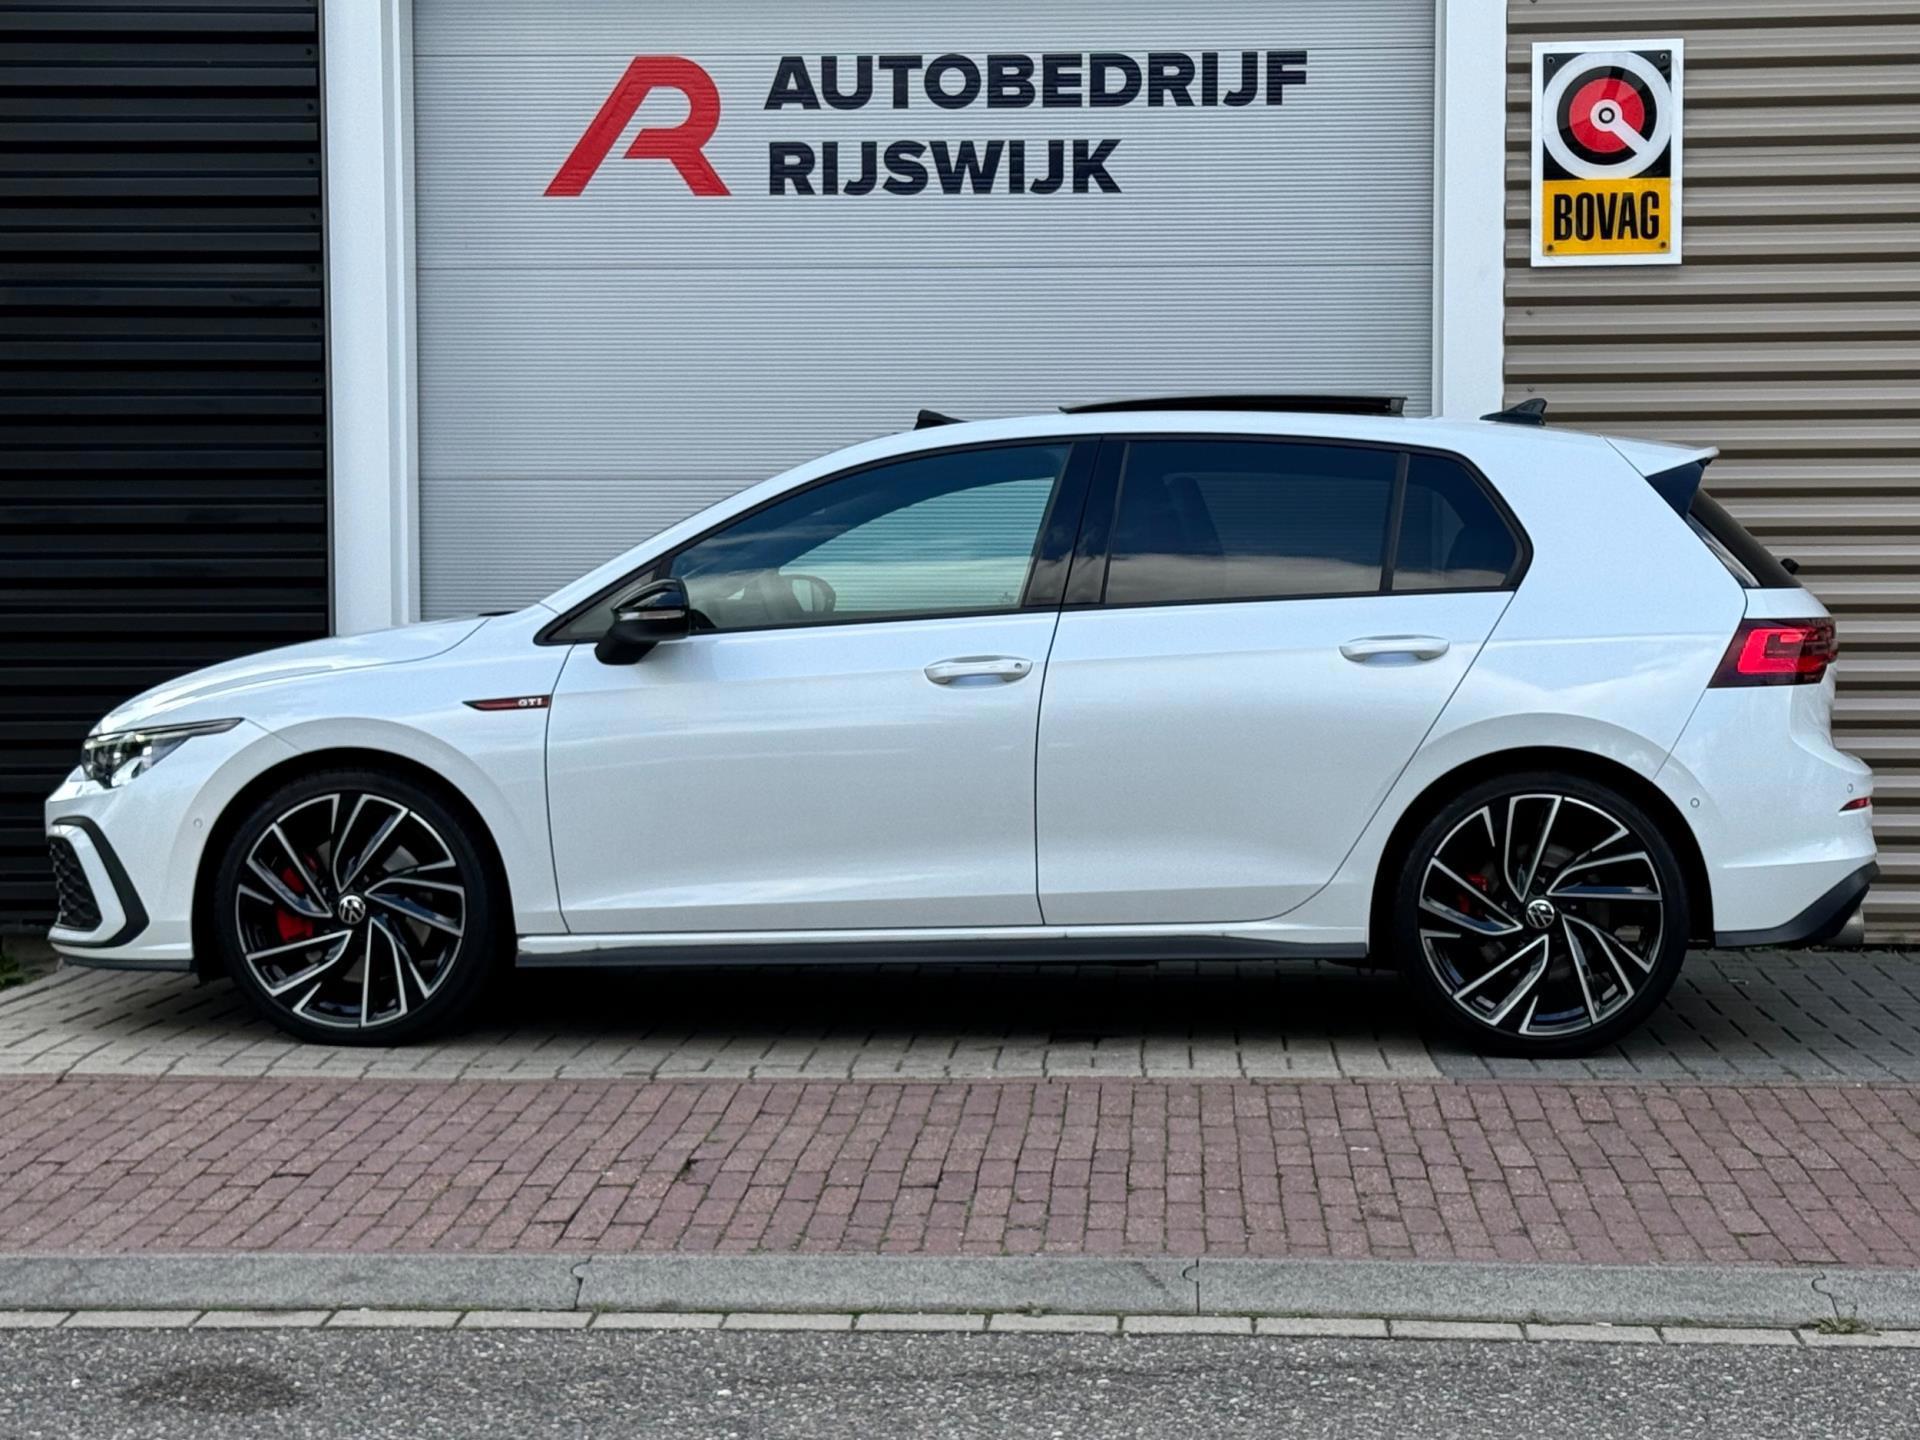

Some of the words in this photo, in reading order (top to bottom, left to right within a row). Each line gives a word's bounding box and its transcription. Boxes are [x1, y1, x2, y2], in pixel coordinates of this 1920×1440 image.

[764, 50, 1308, 111] AUTOBEDRIJF
[769, 139, 1121, 196] RIJSWIJK
[1553, 190, 1660, 241] BOVAG
[518, 697, 543, 706] GTI
